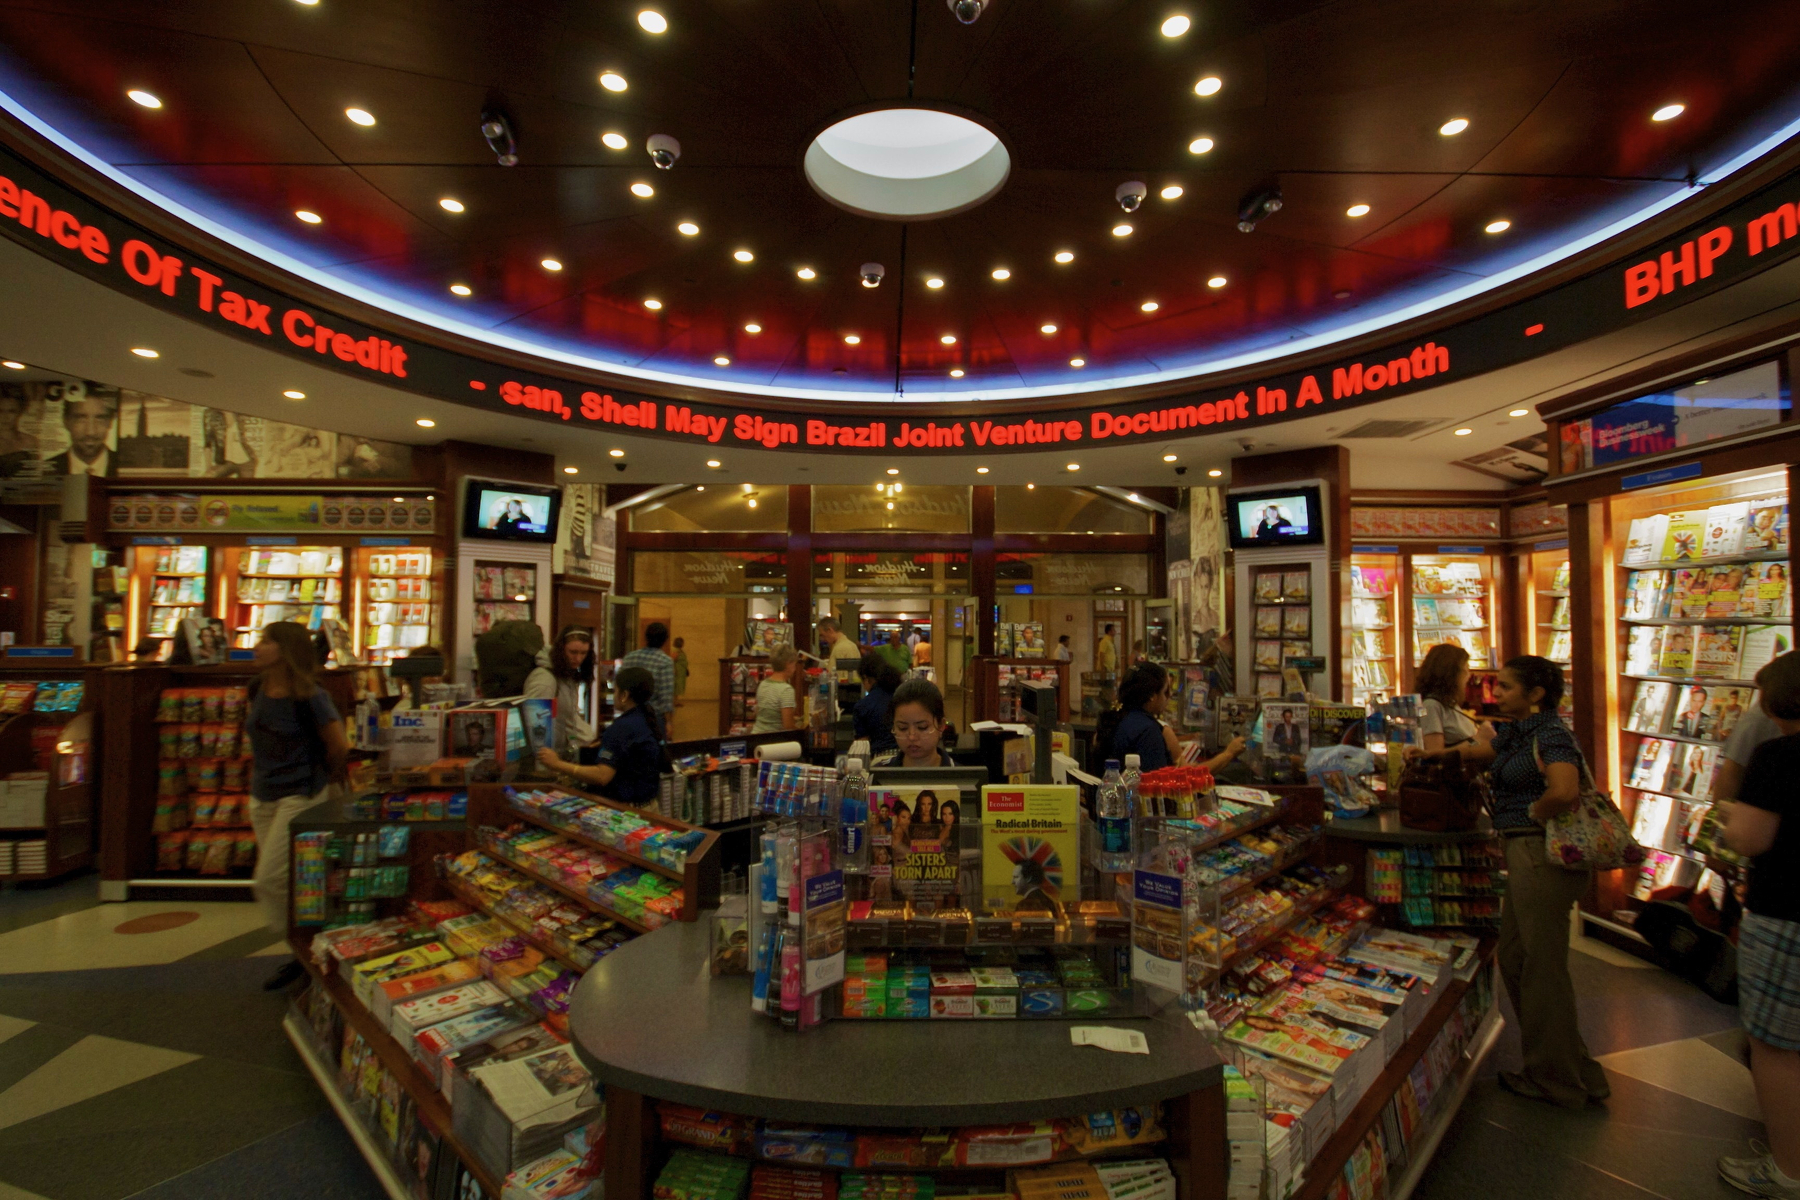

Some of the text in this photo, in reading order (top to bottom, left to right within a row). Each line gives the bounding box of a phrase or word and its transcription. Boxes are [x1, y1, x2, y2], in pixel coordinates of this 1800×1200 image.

[1625, 226, 1733, 309] BHP
[1747, 203, 1800, 257] m
[122, 239, 183, 297] Of
[191, 267, 272, 335] Tax
[282, 309, 408, 378] Credit
[50, 380, 87, 401] GQ
[500, 381, 572, 420] san,
[580, 391, 657, 429] Shell
[665, 405, 728, 443] May
[733, 414, 798, 448] Sign
[806, 419, 886, 448] Brazil
[892, 422, 965, 448] Joint
[969, 420, 1083, 446] Venture
[1091, 391, 1249, 439] Document
[1256, 386, 1287, 416] In
[1295, 375, 1323, 408] A
[1332, 342, 1449, 400] Month
[1599, 419, 1649, 439] Bloomberg
[393, 715, 425, 727] Inc.
[1324, 708, 1365, 718] DISCOVER
[996, 819, 1062, 828] Radical Britain
[847, 828, 856, 854] smart
[905, 853, 946, 866] SISTERS
[894, 866, 922, 880] TORN
[924, 866, 958, 879] APART
[681, 1123, 715, 1141] GRAND
